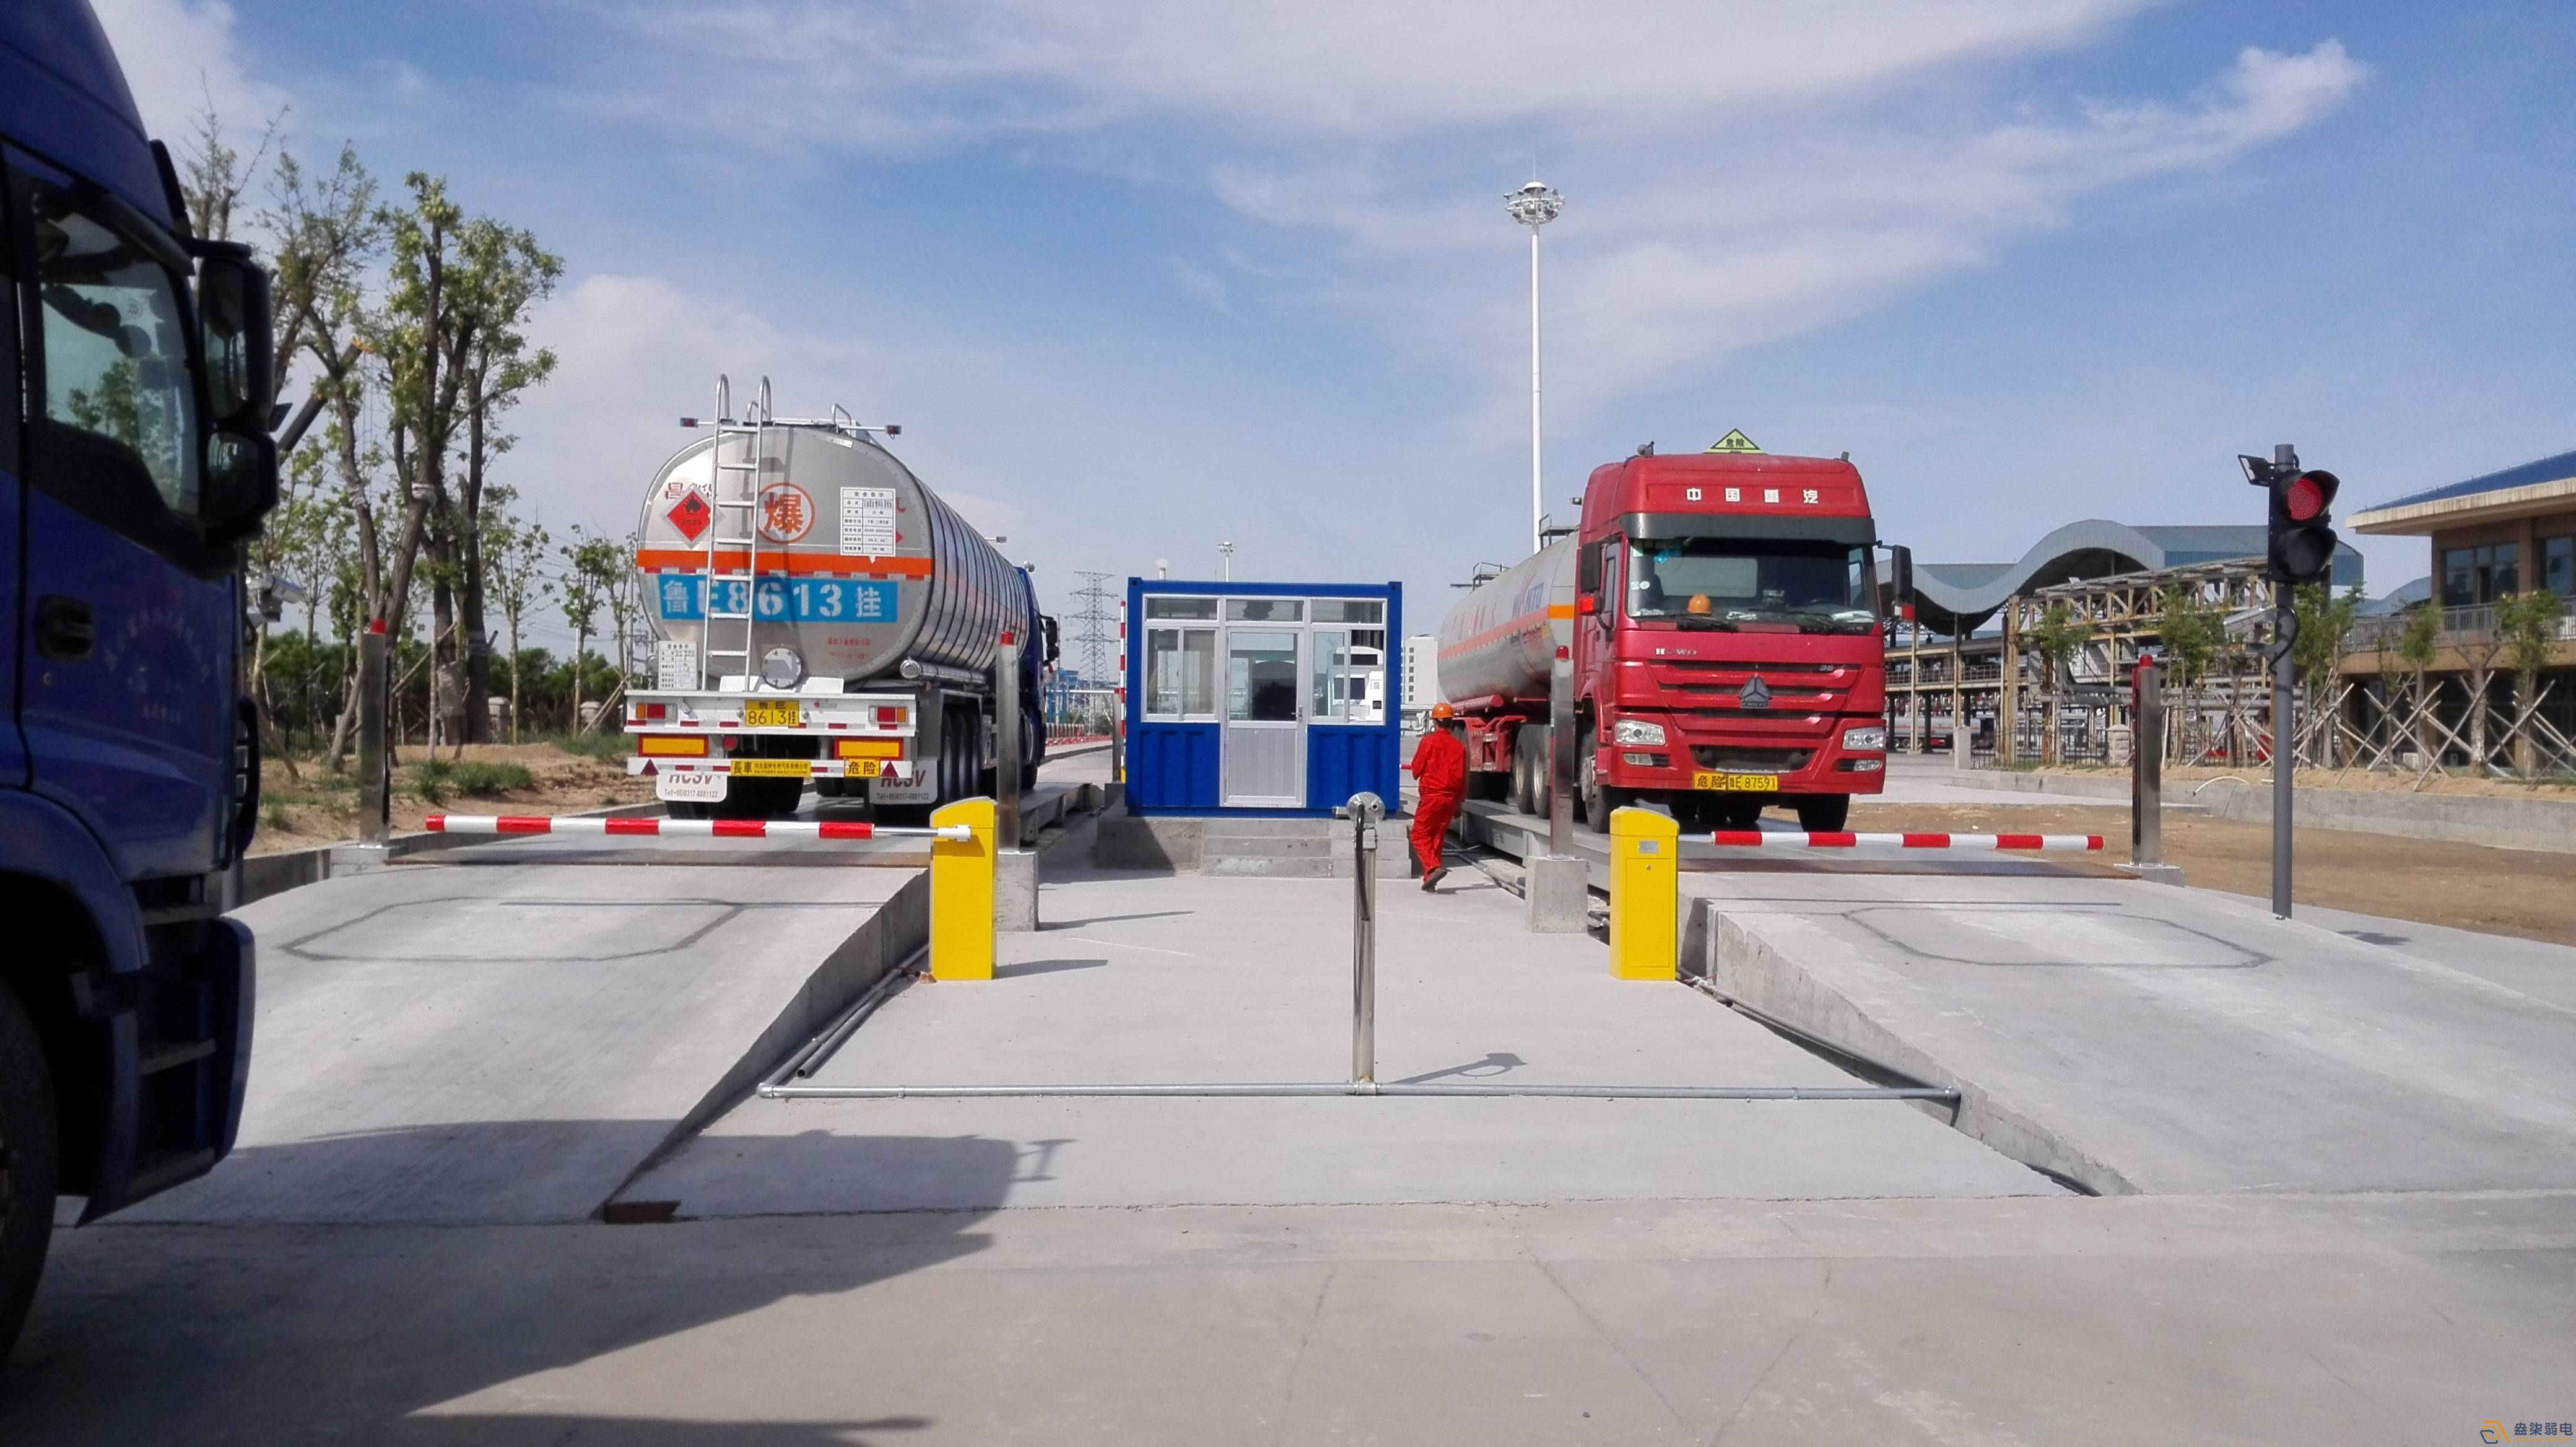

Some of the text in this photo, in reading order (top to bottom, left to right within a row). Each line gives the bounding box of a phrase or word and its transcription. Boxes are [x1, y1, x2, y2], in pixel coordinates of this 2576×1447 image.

[1726, 437, 1744, 447] 危险
[1686, 487, 1819, 504] 中国汽
[764, 492, 804, 533] 爆
[848, 761, 877, 775] 危险
